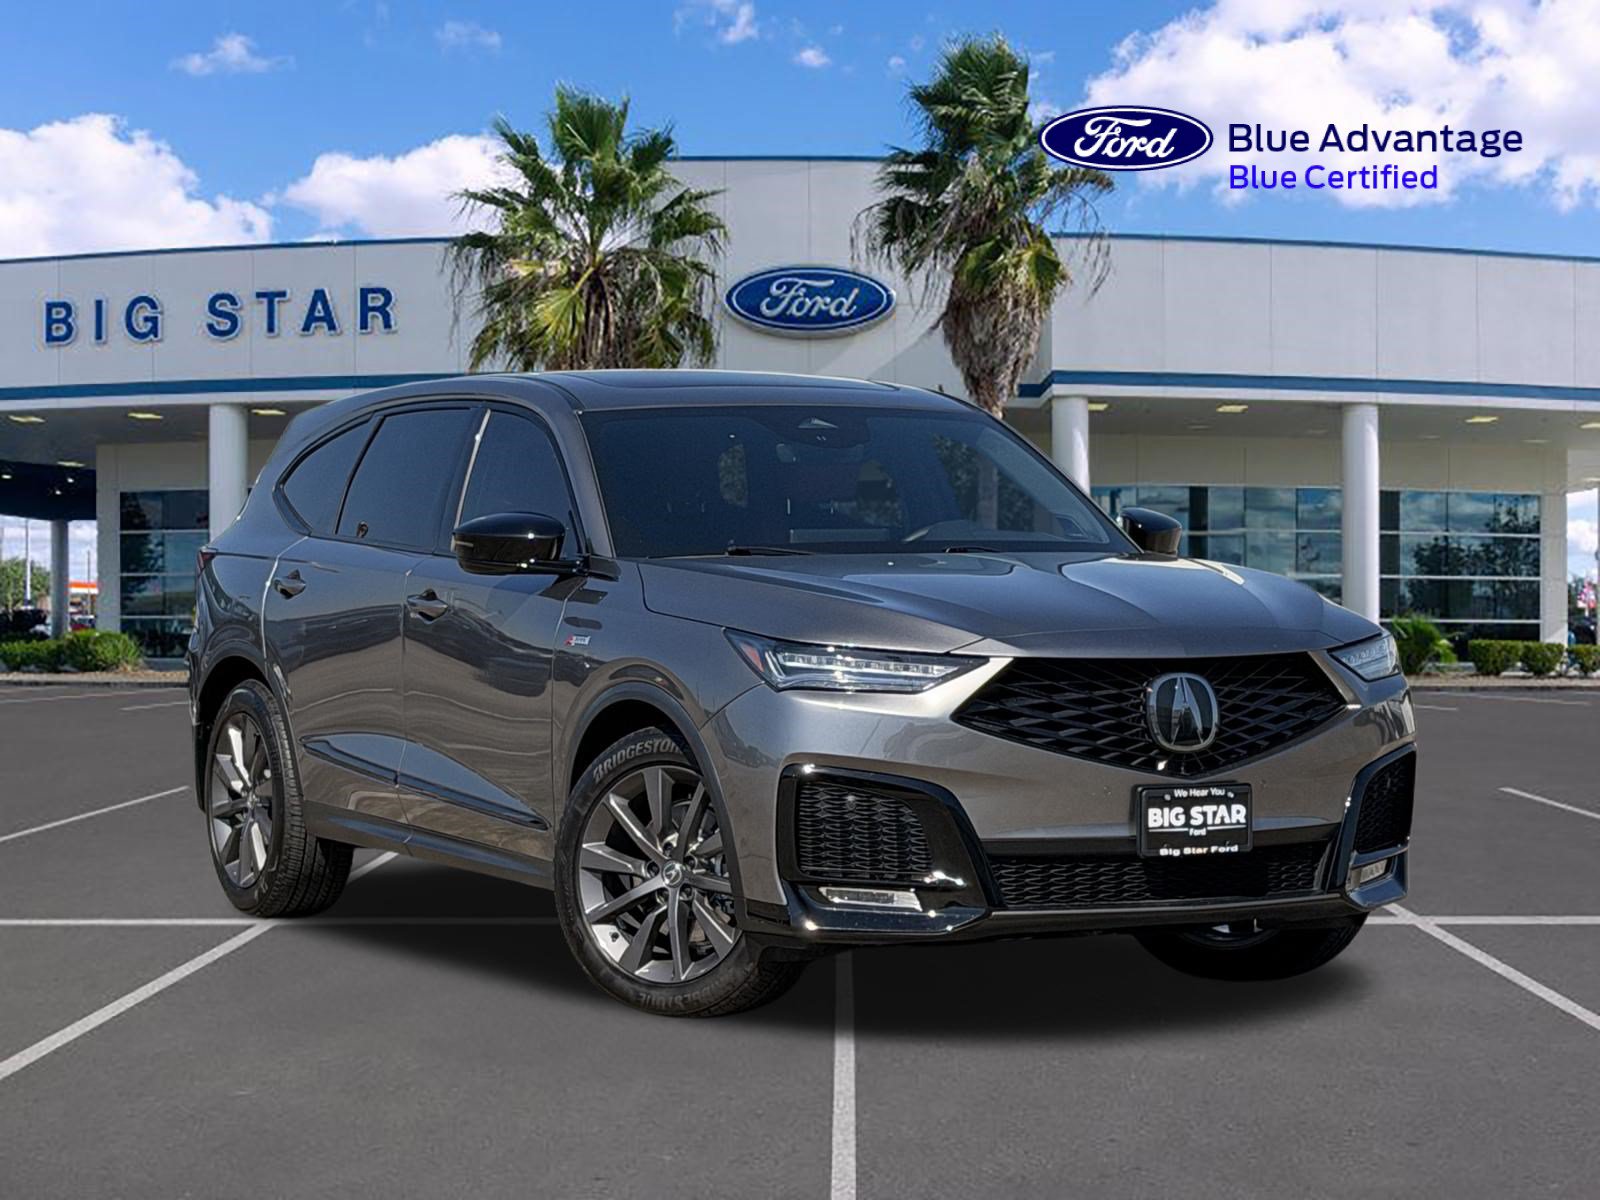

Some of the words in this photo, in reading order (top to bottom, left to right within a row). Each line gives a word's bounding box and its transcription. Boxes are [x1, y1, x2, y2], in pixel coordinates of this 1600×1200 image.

[760, 277, 857, 317] Ford
[44, 295, 162, 345] BIG
[206, 286, 397, 341] STAR
[1174, 788, 1188, 798] We
[1189, 788, 1209, 797] Hear
[1210, 787, 1226, 796] You
[1148, 807, 1185, 828] BIG
[1190, 804, 1246, 826] STAR
[1189, 828, 1207, 836] Ford
[1159, 848, 1180, 856] Big
[1211, 845, 1238, 853] Ford
